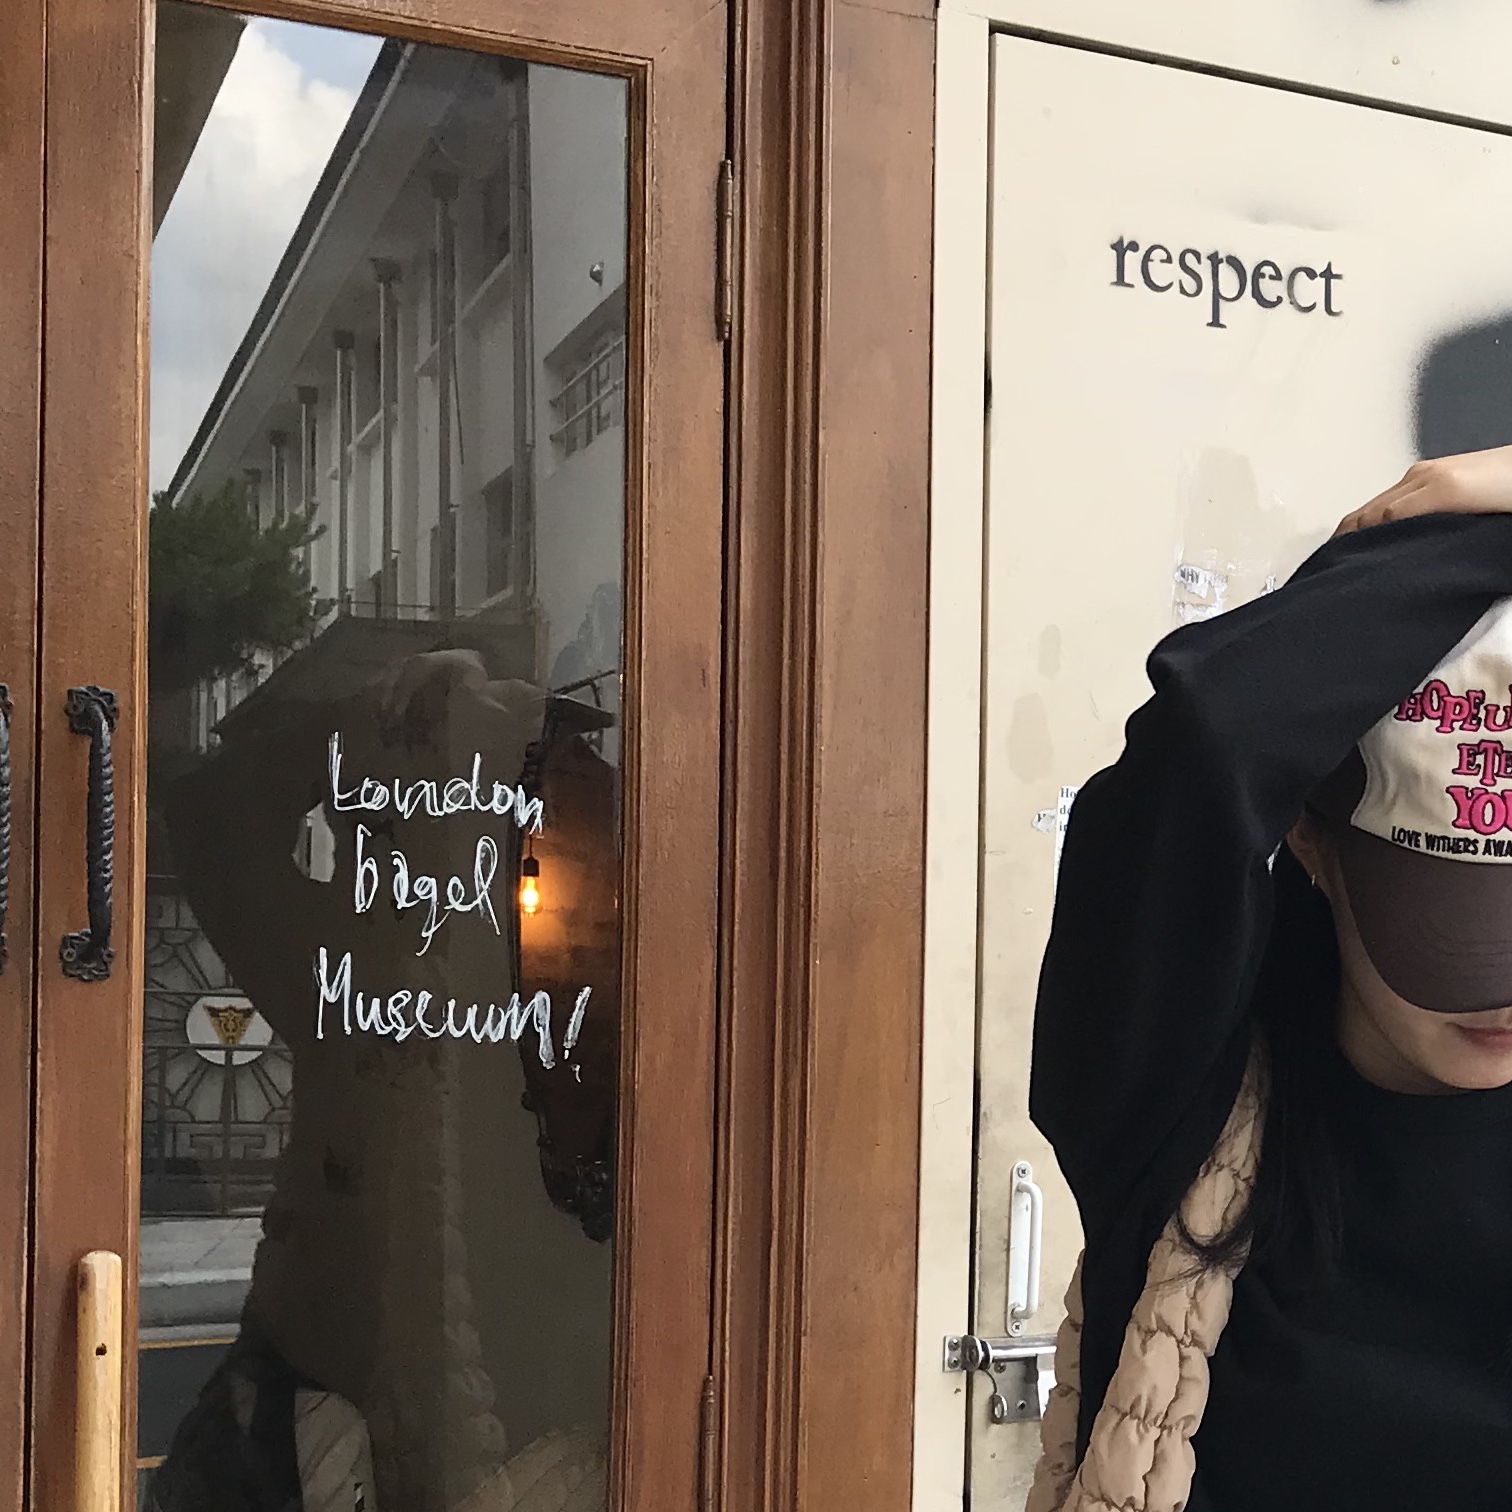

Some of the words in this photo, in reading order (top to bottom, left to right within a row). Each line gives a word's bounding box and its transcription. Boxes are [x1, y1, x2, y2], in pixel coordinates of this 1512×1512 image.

[1110, 235, 1344, 329] respect
[1394, 678, 1485, 733] HOPE
[327, 731, 546, 839] London
[1391, 825, 1421, 848] LOVE
[1425, 832, 1479, 856] WITHERS
